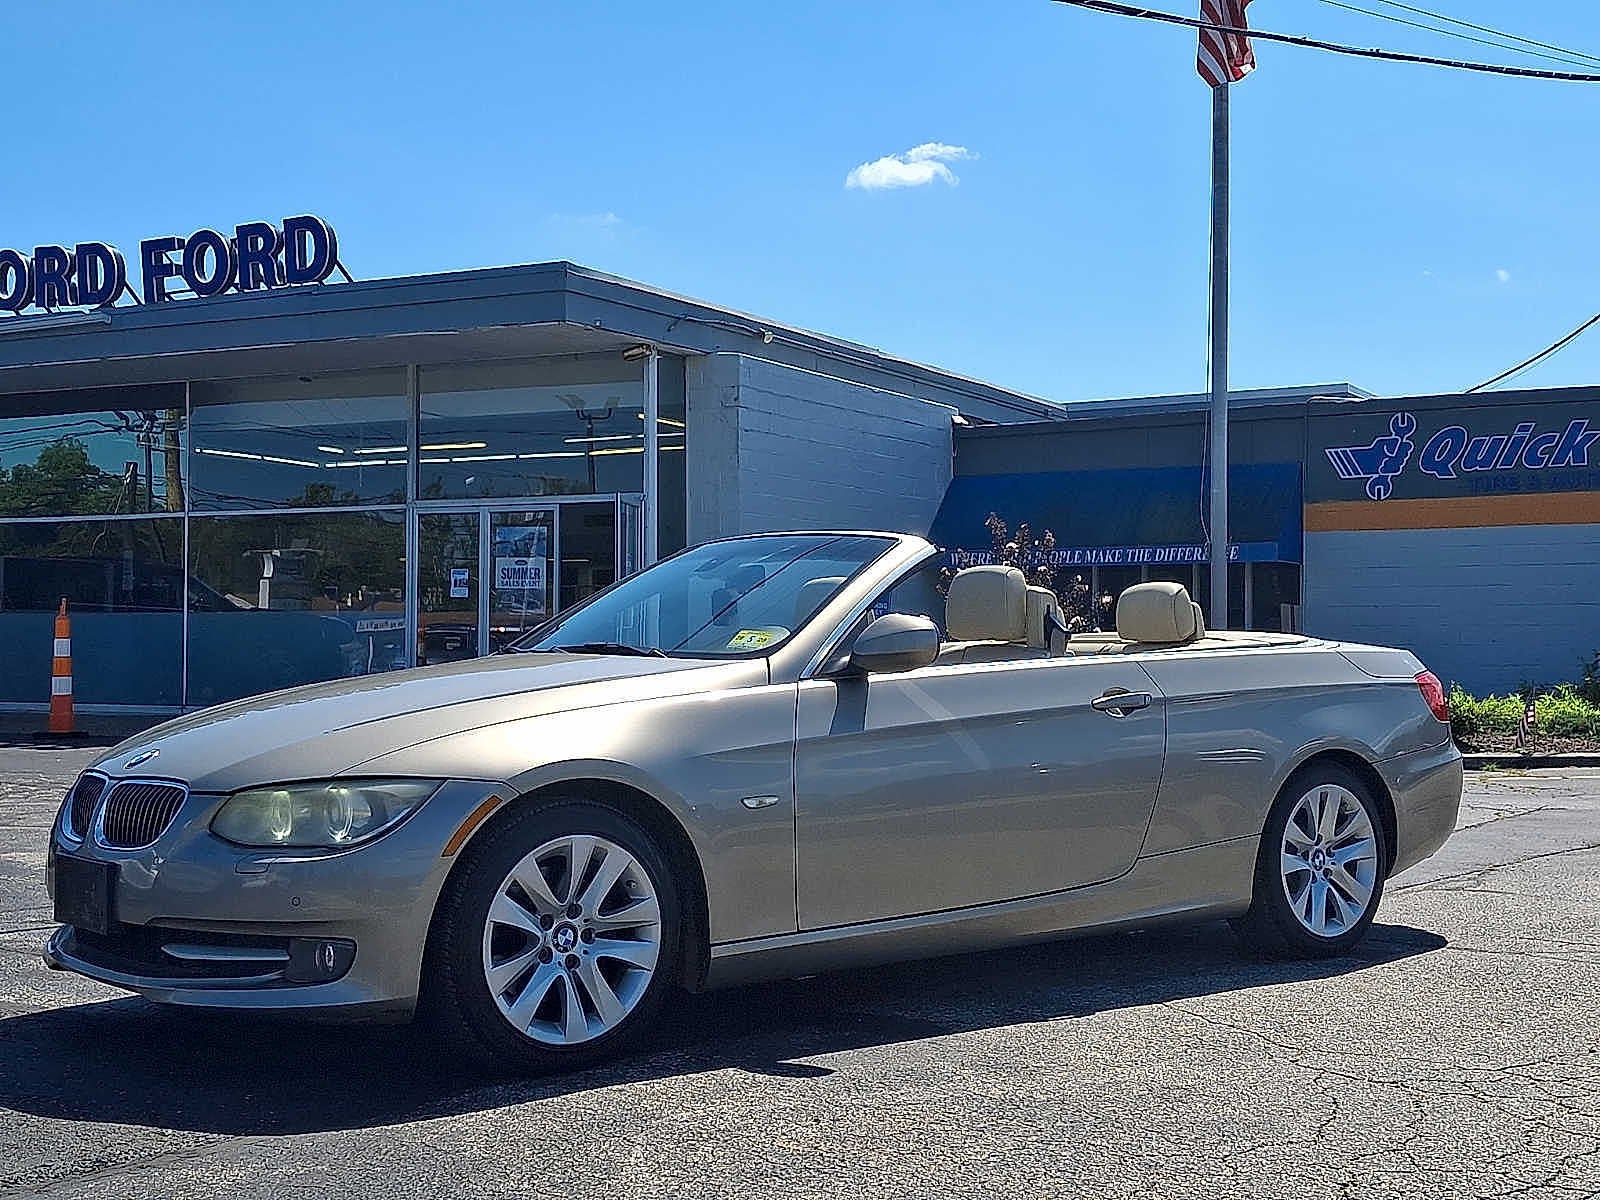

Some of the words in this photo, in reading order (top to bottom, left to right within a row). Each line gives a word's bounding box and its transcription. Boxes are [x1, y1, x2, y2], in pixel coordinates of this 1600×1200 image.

[141, 214, 338, 305] FORD
[1419, 419, 1600, 479] Quick
[500, 567, 541, 580] SUMMER
[1084, 549, 1123, 563] MAKE
[1127, 548, 1153, 562] THE
[1155, 546, 1239, 562] DIFFERE
